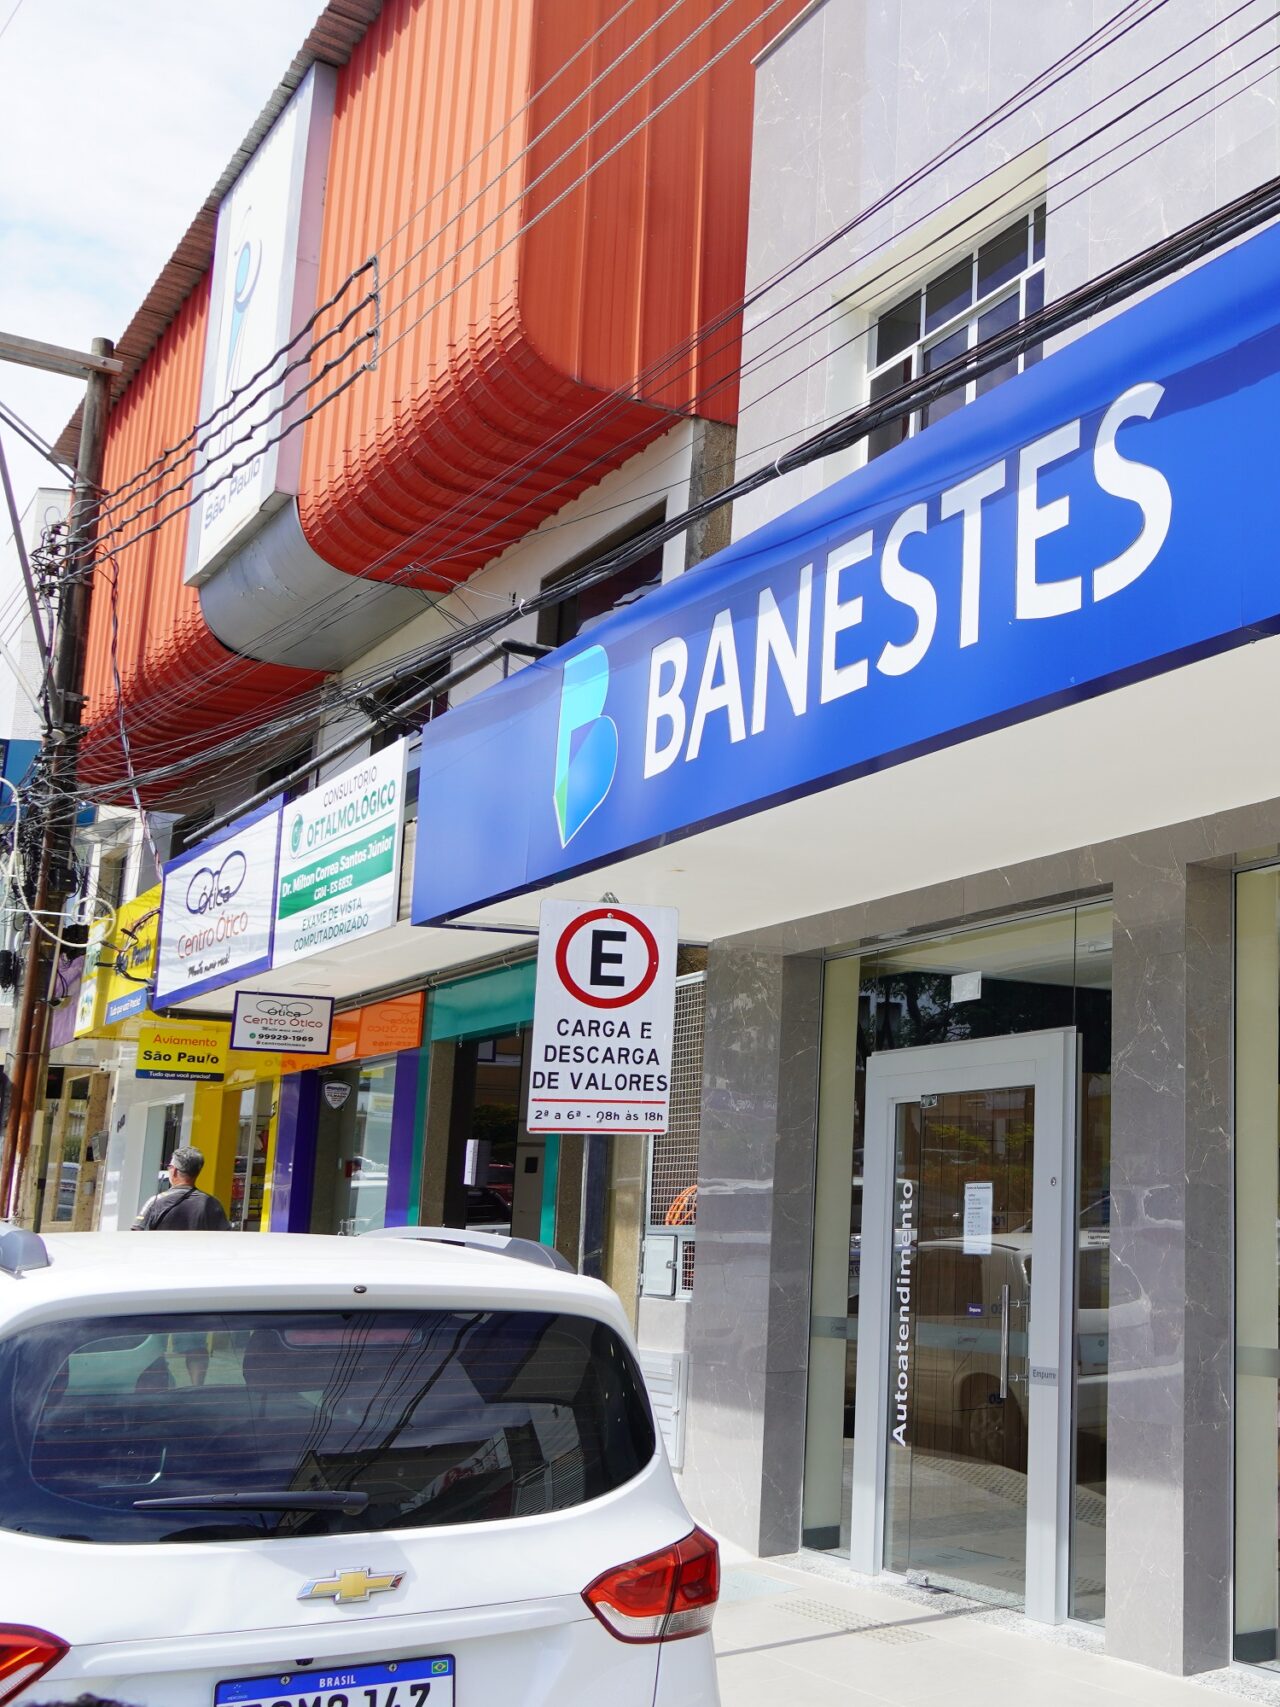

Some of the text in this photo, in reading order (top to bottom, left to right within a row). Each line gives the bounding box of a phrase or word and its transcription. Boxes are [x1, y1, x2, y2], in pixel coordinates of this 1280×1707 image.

[643, 381, 1172, 779] BANESTES
[323, 765, 378, 808] CONSULTÓRIO
[306, 779, 396, 848] OFTALMOLÓGICO
[282, 882, 293, 898] Dr.
[293, 873, 315, 894] Milton
[340, 850, 366, 870] Santos
[367, 835, 394, 861] Júnior
[330, 880, 339, 894] ES
[301, 897, 362, 932] EXAME DE VISTA
[177, 910, 249, 960] Centro Ótico
[293, 913, 369, 952] COMPUTADORIZADO
[590, 929, 627, 987] E
[243, 1015, 323, 1029] Centro Ótico
[556, 1018, 653, 1039] CARGA E
[153, 1033, 218, 1047] Aviamento
[258, 1033, 314, 1043] 99929-1969
[143, 1049, 219, 1064] São Paulo
[544, 1045, 660, 1066] DESCARGA
[532, 1071, 668, 1092] DE VALORES
[554, 1112, 561, 1120] a
[596, 1110, 620, 1121] 08h
[625, 1109, 639, 1121] às
[644, 1111, 663, 1121] 18h
[893, 1181, 913, 1447] Autoatendimento
[1032, 1369, 1056, 1380] Empurre
[319, 1674, 357, 1689] BRASIL
